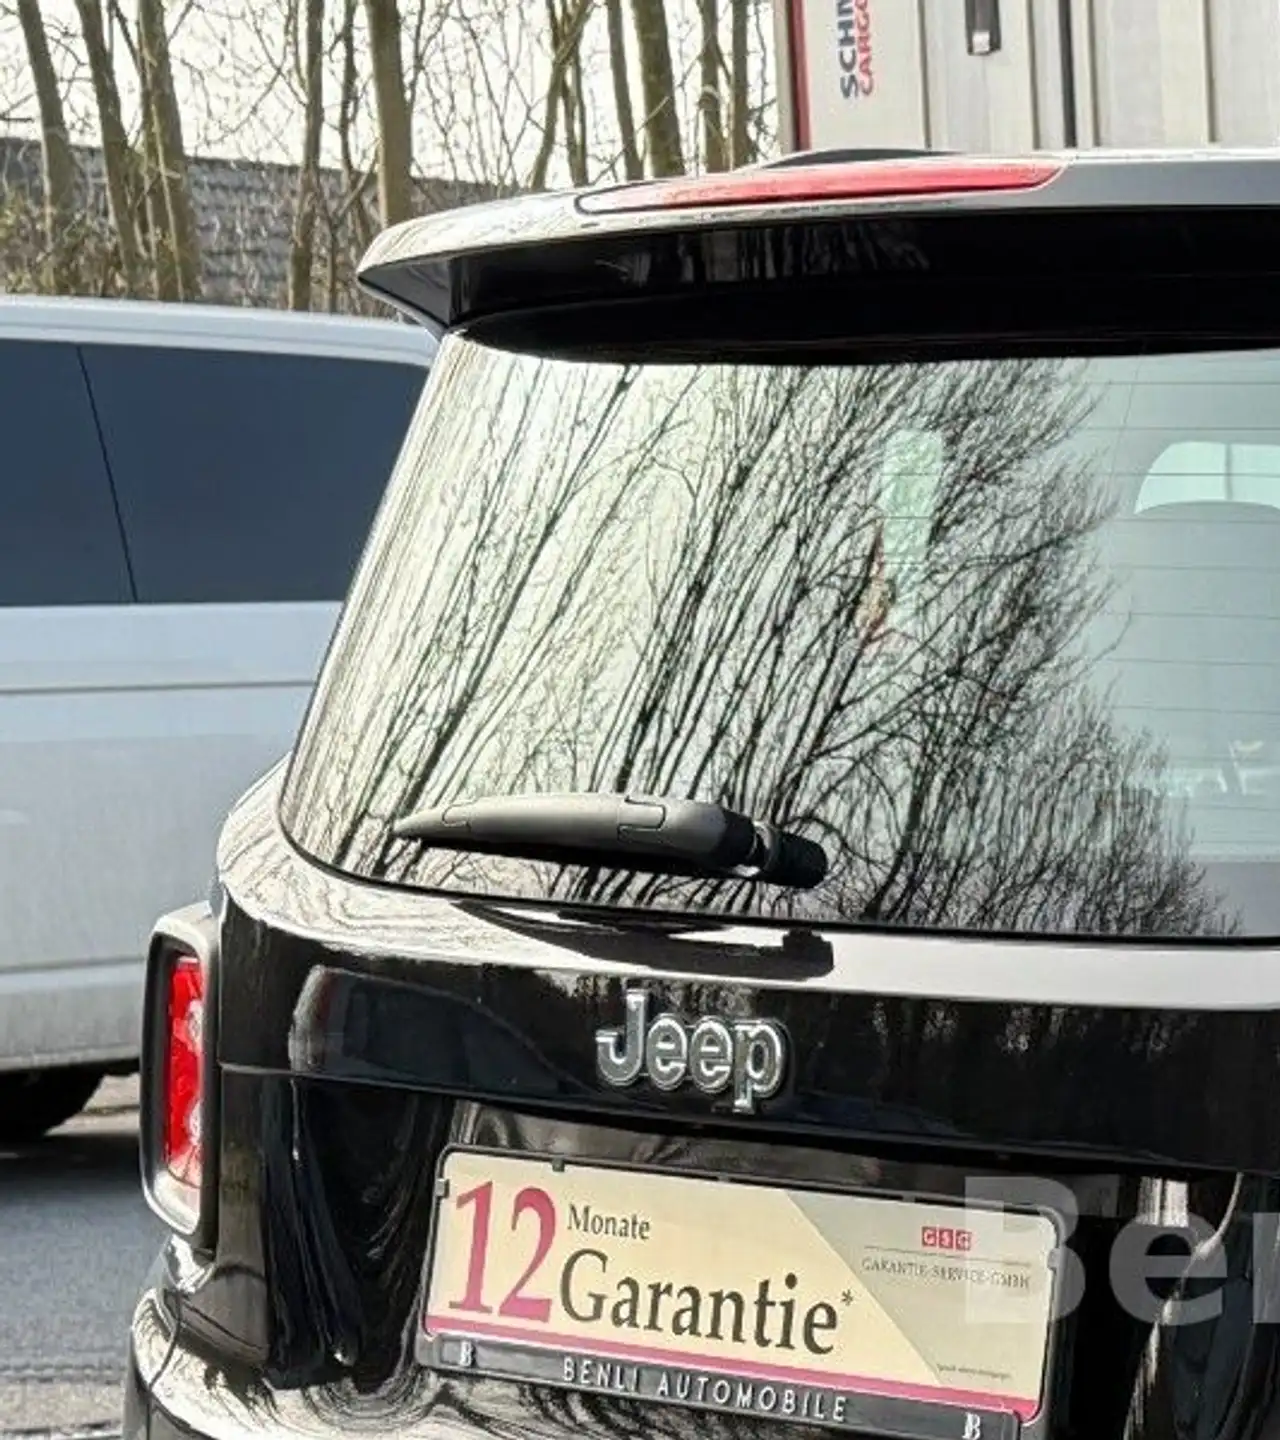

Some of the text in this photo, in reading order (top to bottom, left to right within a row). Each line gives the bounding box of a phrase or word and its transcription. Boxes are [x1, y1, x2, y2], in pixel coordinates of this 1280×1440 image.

[595, 990, 786, 1116] Jeep
[448, 1179, 651, 1324] 12 Monate
[562, 1356, 640, 1393] BENLI
[656, 1377, 848, 1423] AUTOMOBILE
